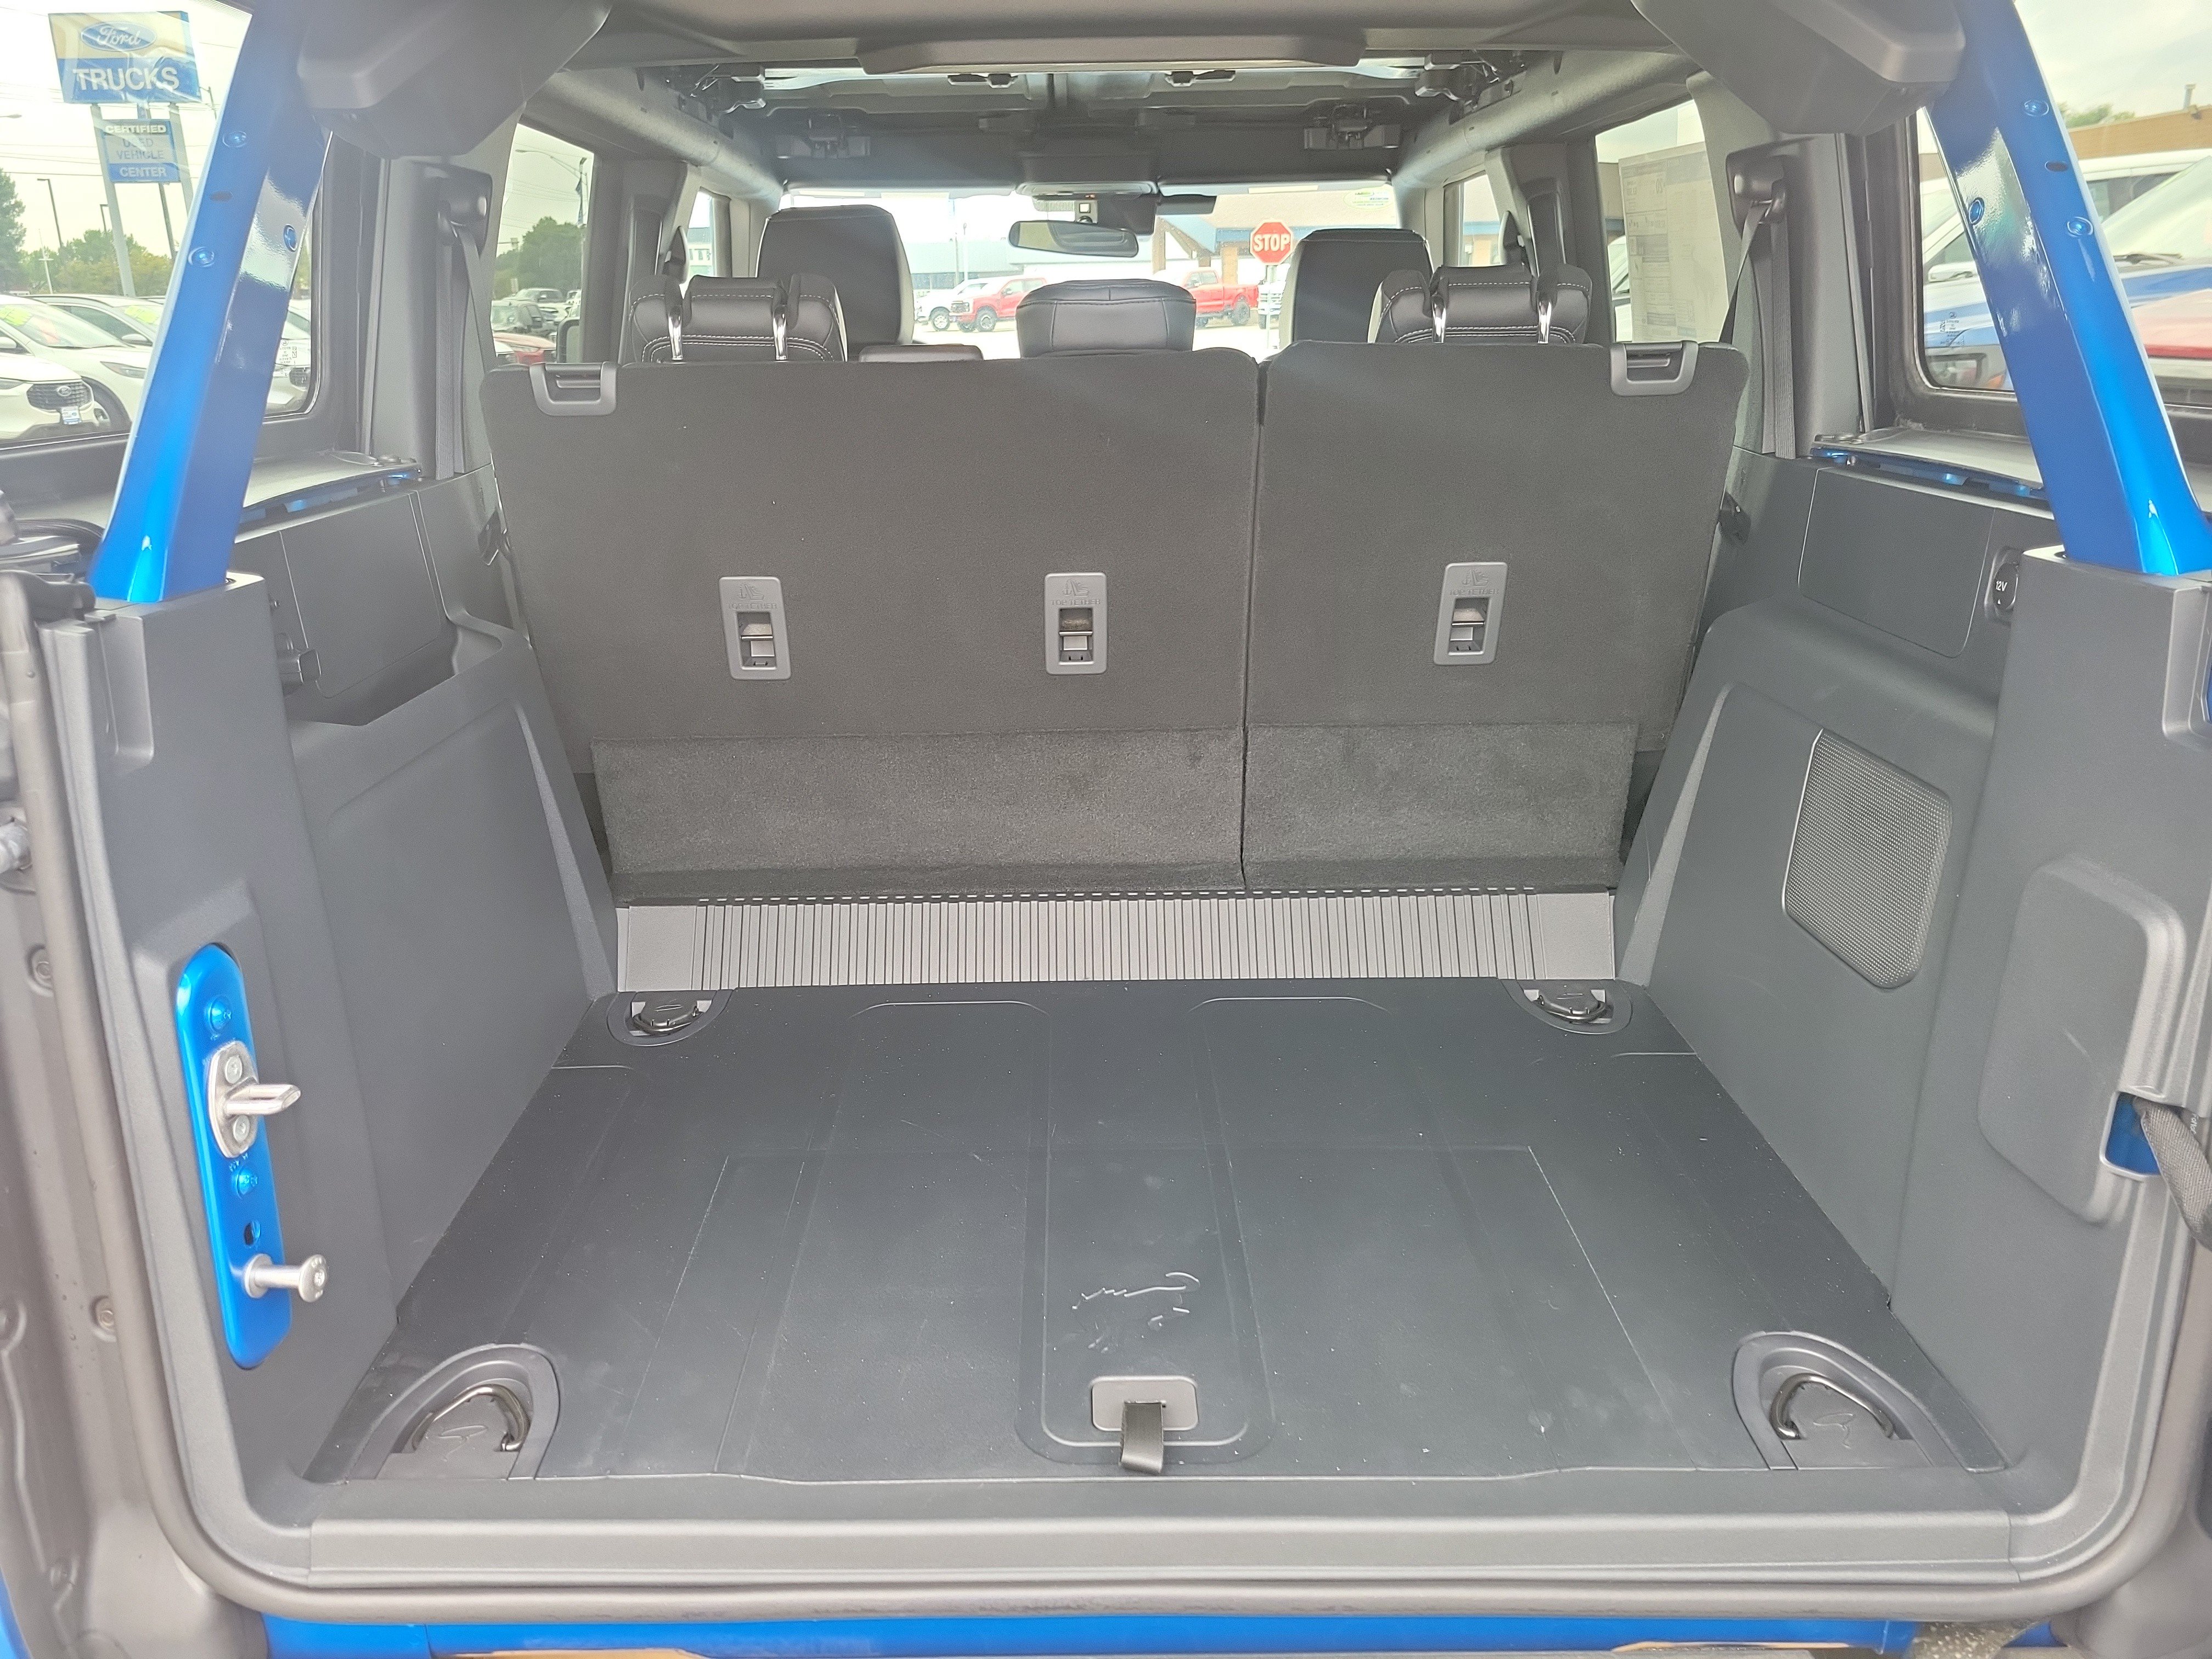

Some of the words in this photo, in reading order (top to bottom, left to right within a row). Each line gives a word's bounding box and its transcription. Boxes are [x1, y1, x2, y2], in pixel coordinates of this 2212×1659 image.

[98, 26, 143, 46] Ford
[73, 67, 180, 91] TRUCKS
[105, 125, 167, 134] CERTIFIED
[120, 167, 167, 177] CENTER
[1254, 233, 1290, 252] STOP
[1996, 580, 2008, 592] 12V
